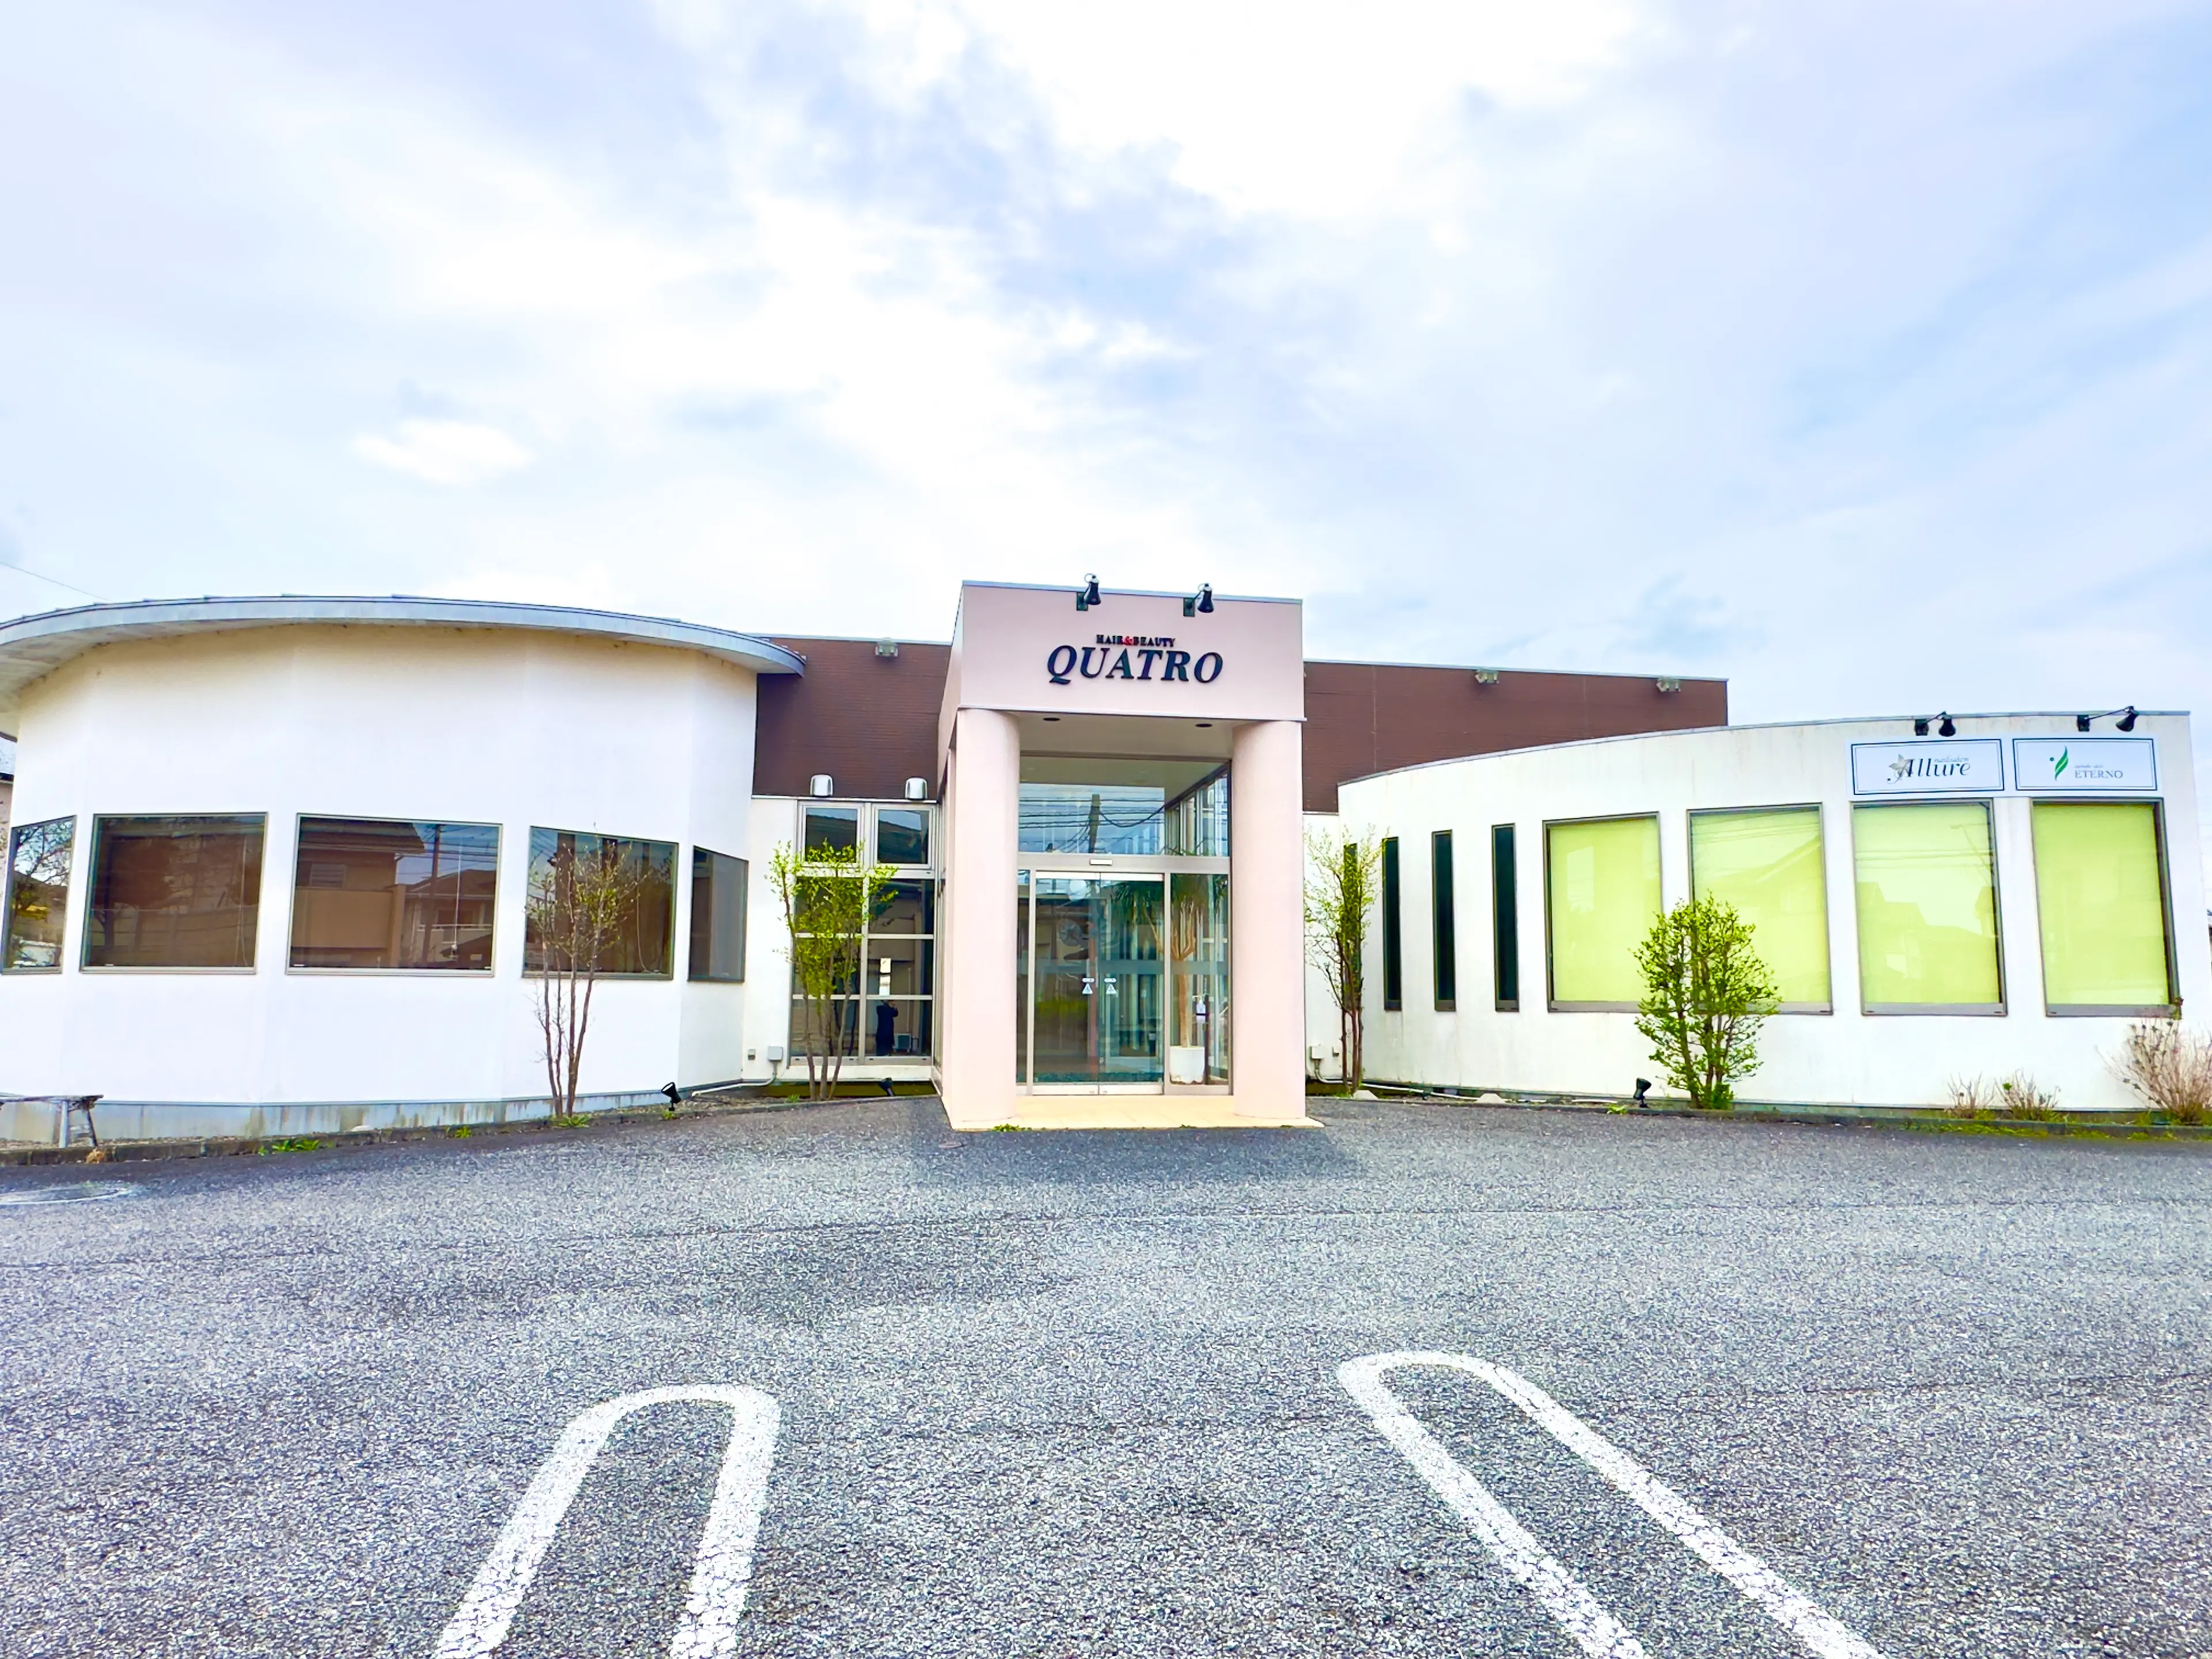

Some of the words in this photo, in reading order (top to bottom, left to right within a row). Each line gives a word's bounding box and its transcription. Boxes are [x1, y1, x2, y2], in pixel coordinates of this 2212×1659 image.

[1047, 645, 1224, 684] QUATRO
[1887, 758, 1971, 784] Allure
[2075, 770, 2123, 778] ETERNO
